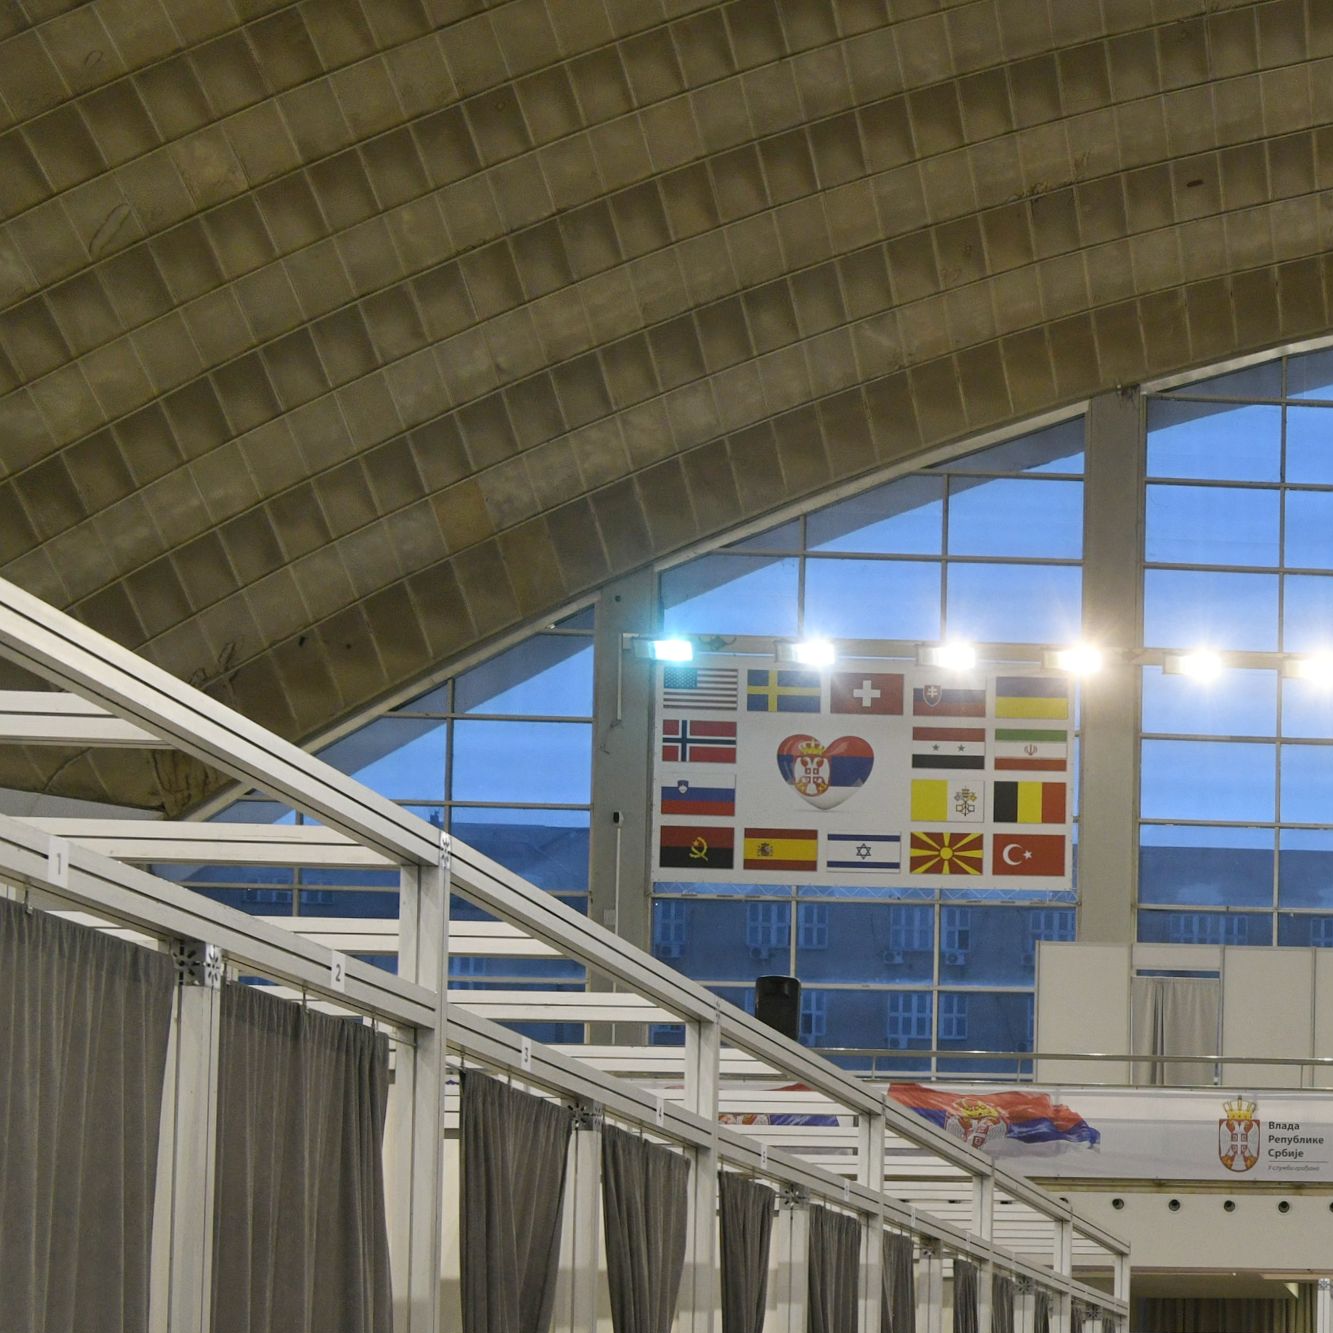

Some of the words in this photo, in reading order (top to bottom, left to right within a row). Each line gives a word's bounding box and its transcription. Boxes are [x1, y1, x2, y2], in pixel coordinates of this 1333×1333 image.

[336, 963, 341, 982] 2
[1268, 1121, 1300, 1131] Влада
[1268, 1135, 1324, 1145] Републике
[1268, 1149, 1304, 1159] Србије
